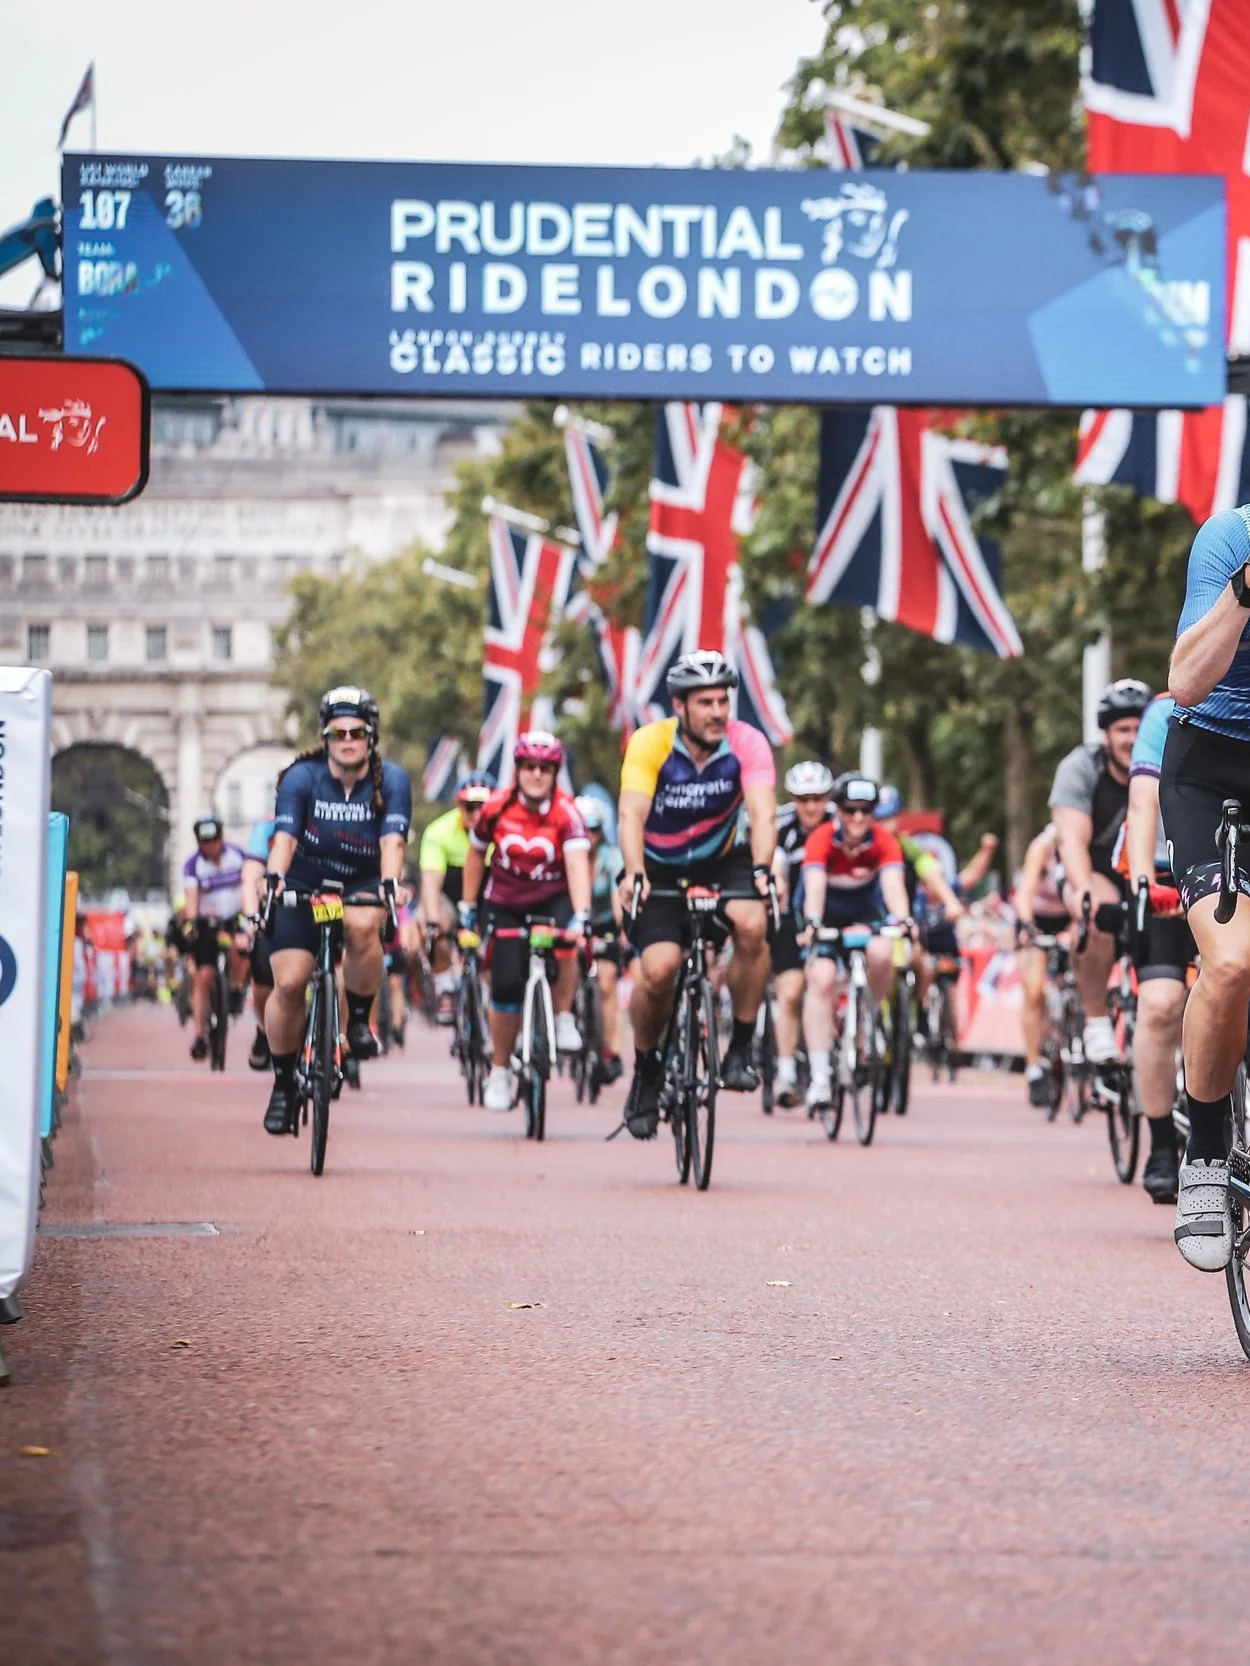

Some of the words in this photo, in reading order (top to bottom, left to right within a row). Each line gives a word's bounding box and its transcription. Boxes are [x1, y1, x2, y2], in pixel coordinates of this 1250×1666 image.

[79, 189, 131, 230] 107
[390, 199, 804, 261] PRUDENTIAL
[390, 260, 912, 321] RIDELONDON
[389, 343, 567, 376] CLASSIC
[580, 341, 713, 373] RIDERS
[727, 343, 775, 374] TO
[789, 346, 912, 376] WATCH
[0, 414, 38, 443] AL
